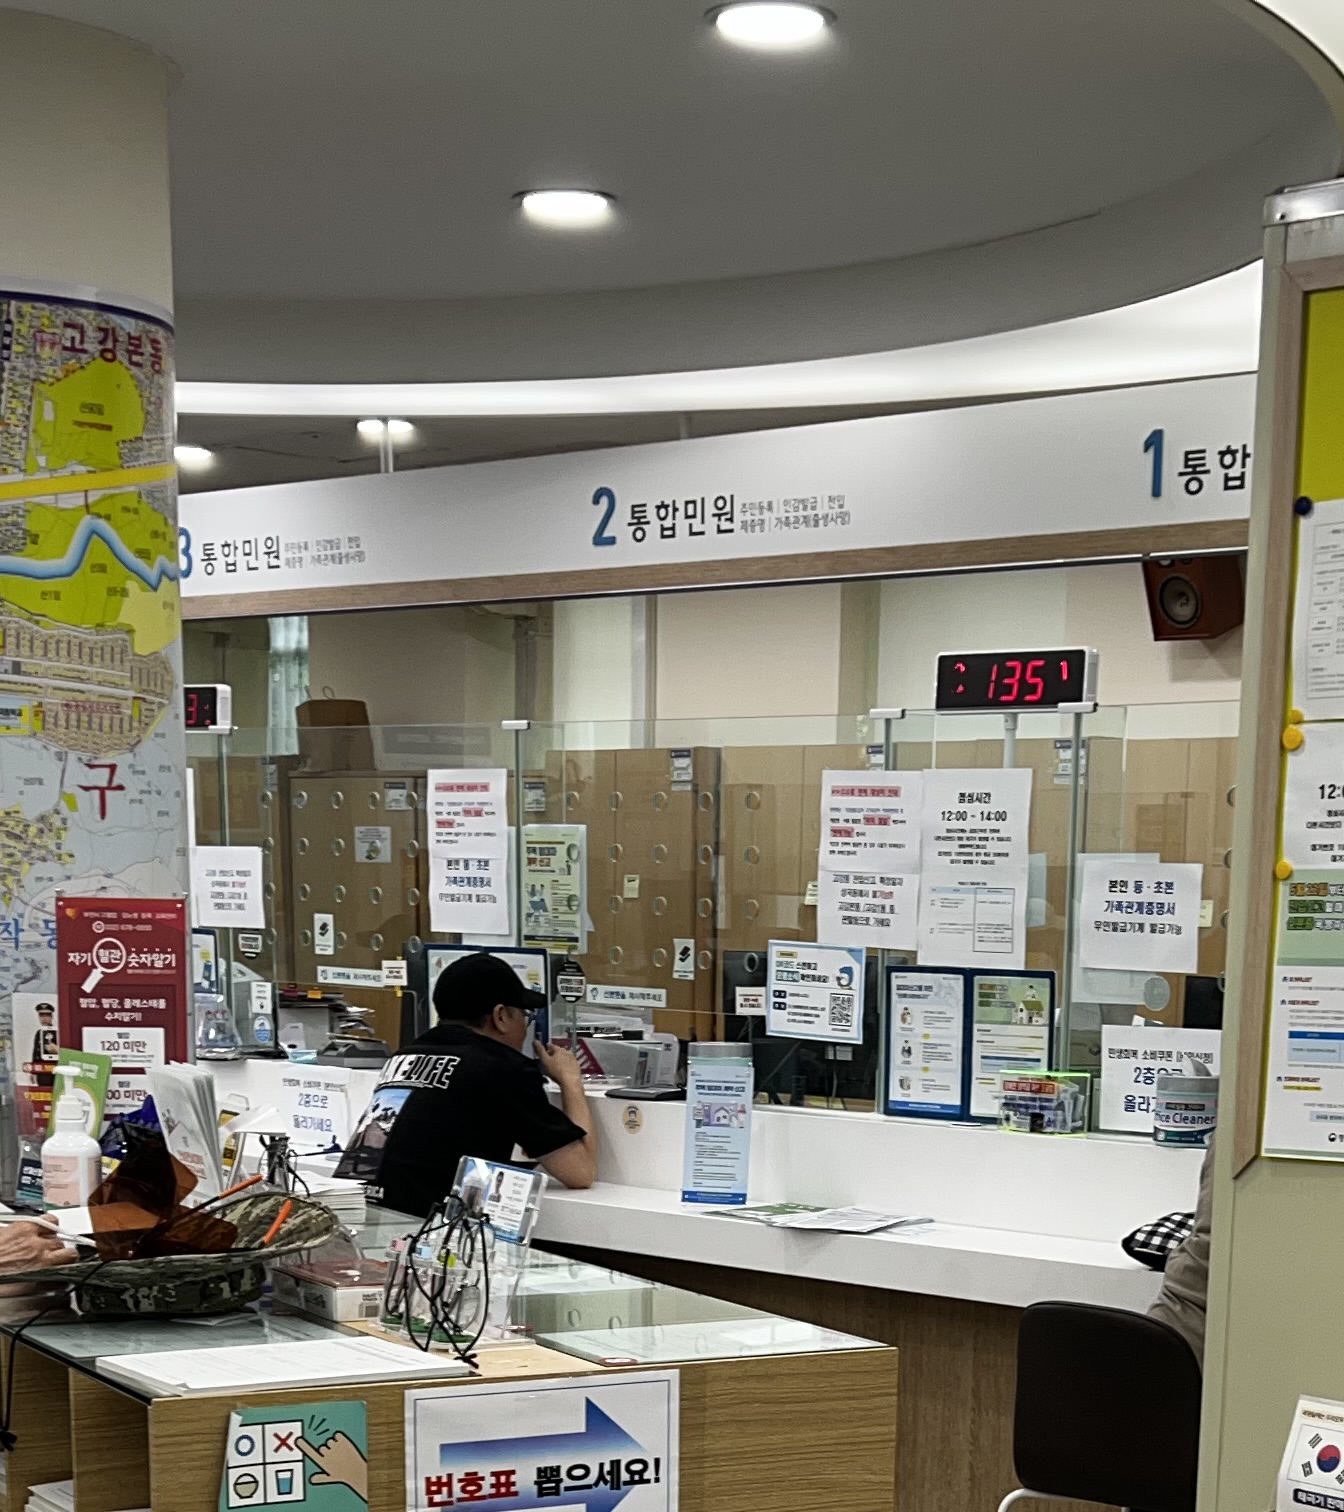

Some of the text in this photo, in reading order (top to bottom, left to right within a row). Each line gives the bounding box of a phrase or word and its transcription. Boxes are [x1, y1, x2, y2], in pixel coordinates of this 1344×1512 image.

[1143, 428, 1252, 499] 1 통합
[592, 486, 735, 547] 2 통합민원
[179, 526, 281, 579] 3 통합민원
[941, 810, 1007, 822] 12:00 14:00
[1108, 880, 1128, 893] 본인
[67, 949, 177, 968] 자기 혈관 숫자알기
[100, 1040, 147, 1053] 120 미만
[1172, 1111, 1217, 1126] Cleaner
[425, 1457, 662, 1508] 번호표 뽑으세요!
